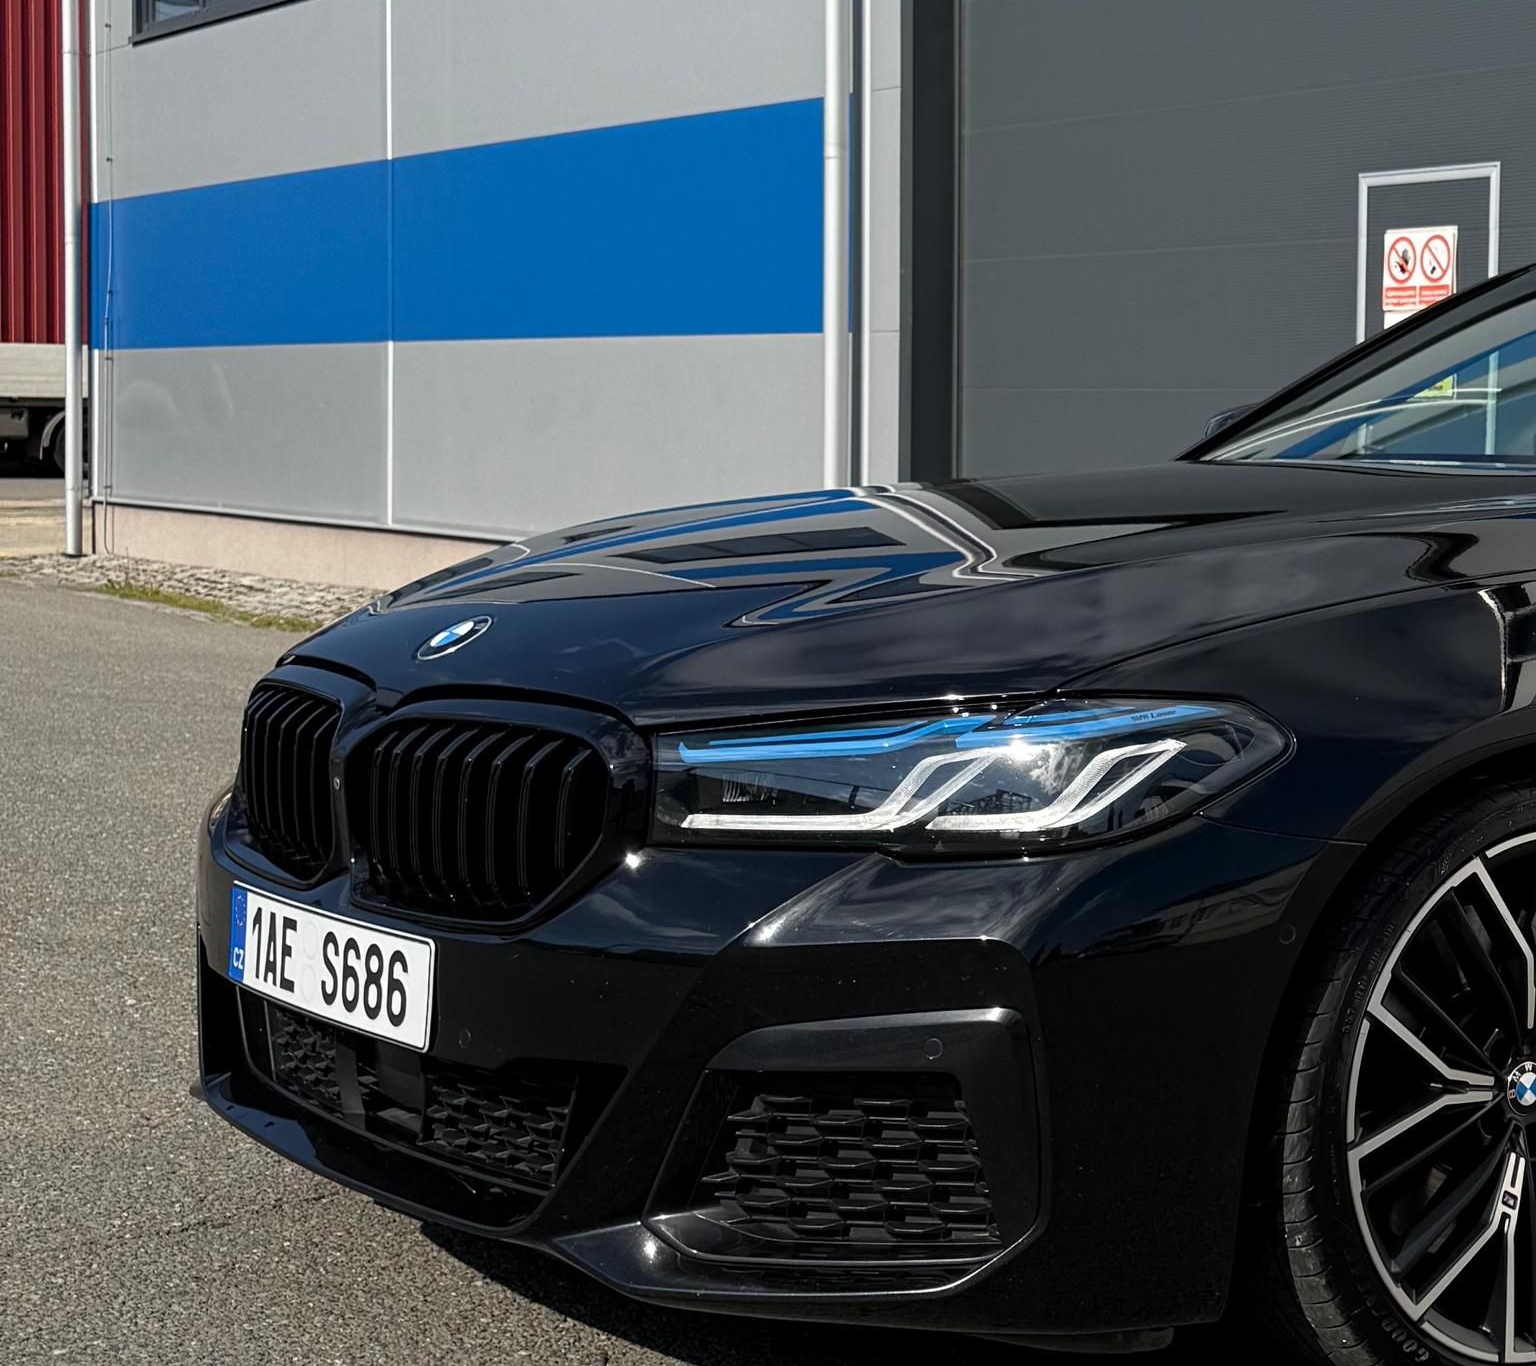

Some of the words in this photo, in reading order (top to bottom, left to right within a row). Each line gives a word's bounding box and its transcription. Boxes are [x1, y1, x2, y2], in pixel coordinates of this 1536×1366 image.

[232, 946, 245, 970] CZ
[251, 906, 298, 994] 1AE
[320, 931, 409, 1027] S686
[1508, 1062, 1534, 1099] BMW
